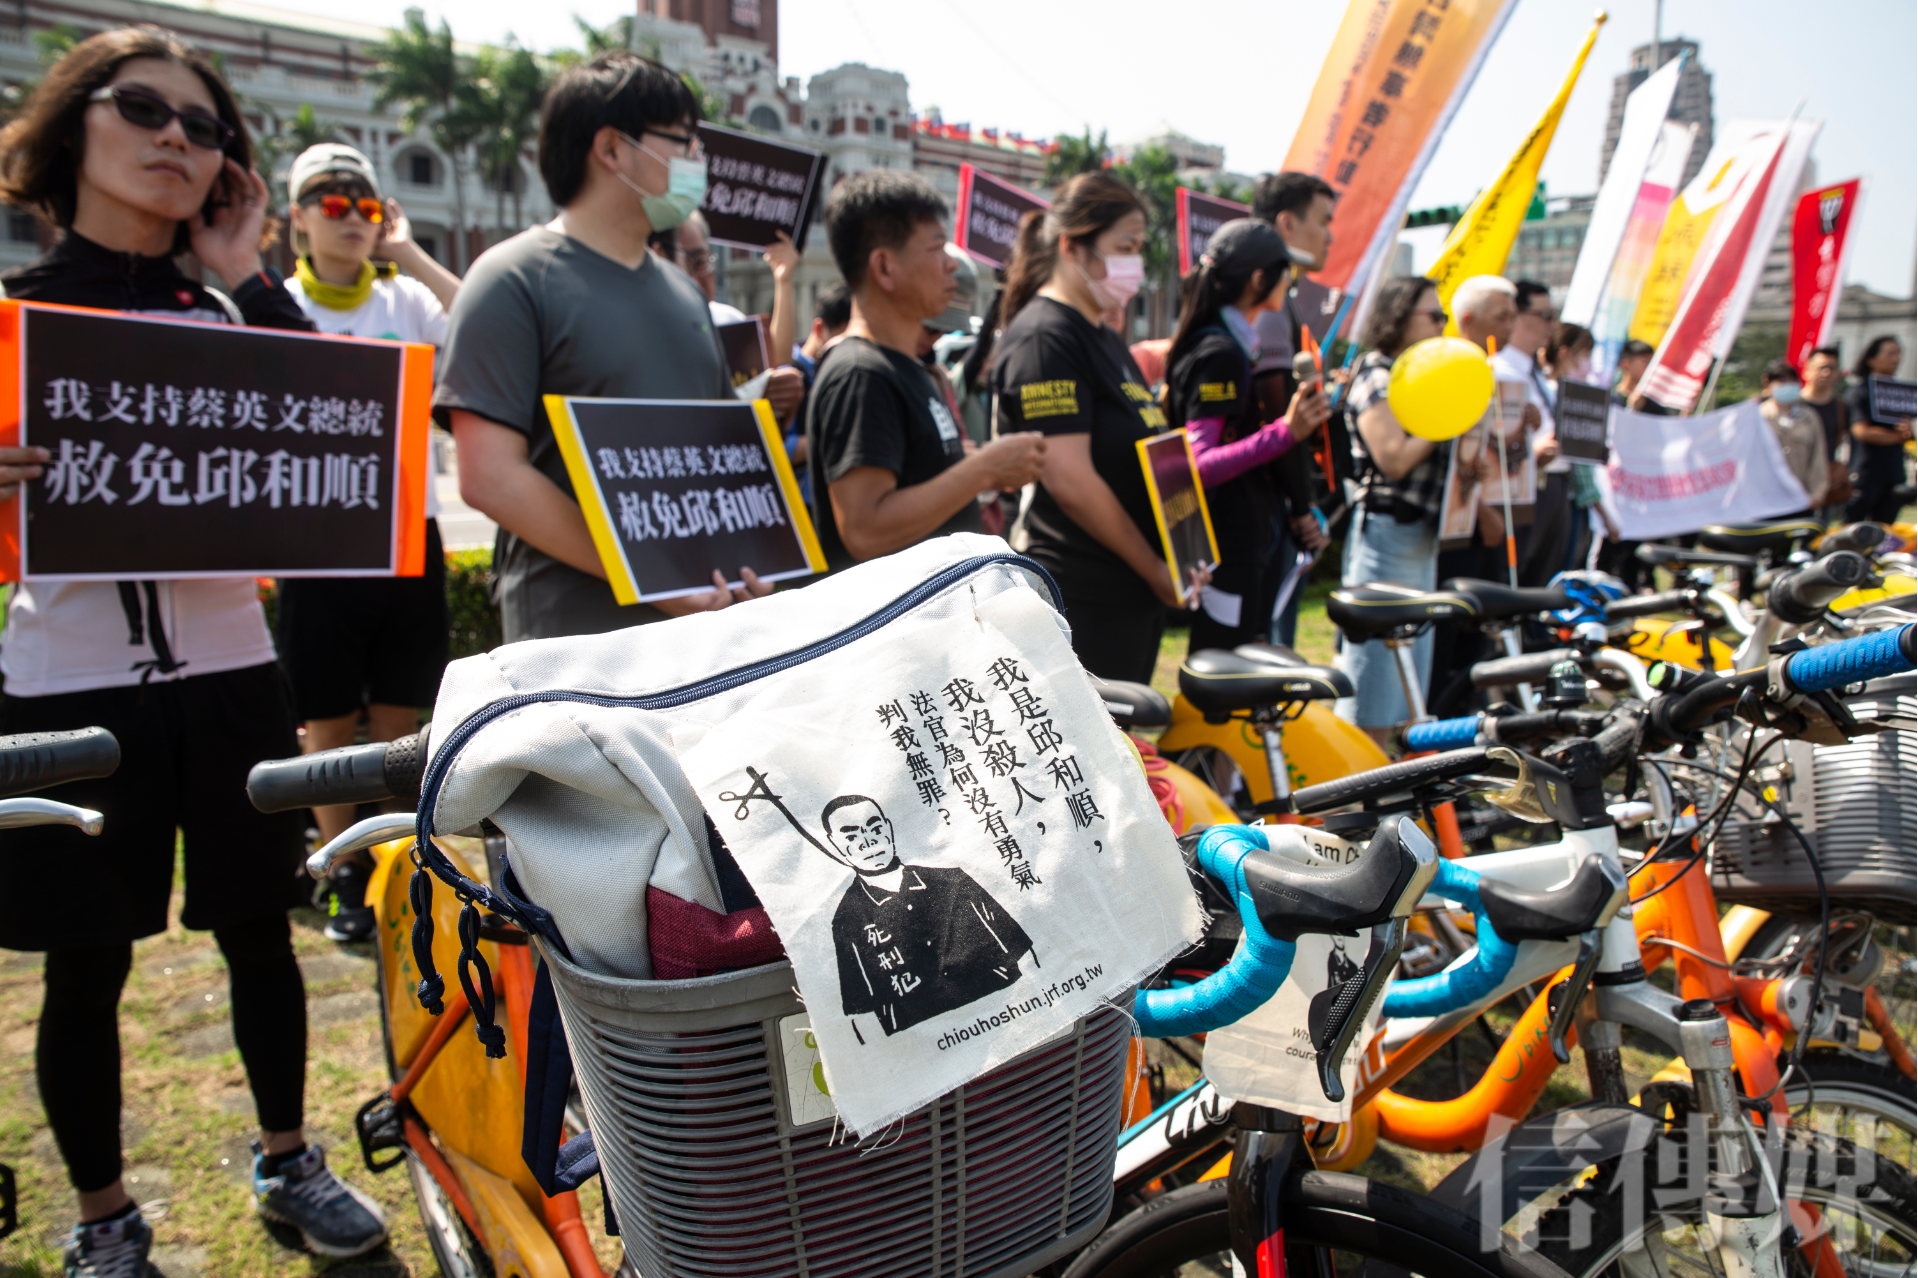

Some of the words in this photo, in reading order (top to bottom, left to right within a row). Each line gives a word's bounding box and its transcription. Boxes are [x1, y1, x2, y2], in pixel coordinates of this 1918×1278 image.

[700, 152, 805, 195] 支持蔡英文總統
[701, 181, 799, 227] 免邱和順
[44, 377, 384, 437] 我支持蔡英文總統
[1021, 379, 1076, 400] AMNESTY
[44, 438, 381, 510] 赦免邱和順
[597, 443, 767, 479] 我支持蔡英文總統
[617, 482, 786, 542] 赦免邱和順
[875, 699, 951, 825] 判我無罪？
[940, 677, 1046, 836] 我沒殺人，
[985, 656, 1105, 854] 我是邱和順，
[909, 690, 1042, 892] 法官為何沒有勇氣
[1314, 843, 1340, 863] am
[1259, 880, 1300, 902] SHIMANO
[864, 923, 922, 996] 死刑犯
[937, 963, 1103, 1050] chiouhoshun.jrf.org.tw
[1292, 1026, 1311, 1044] Wh
